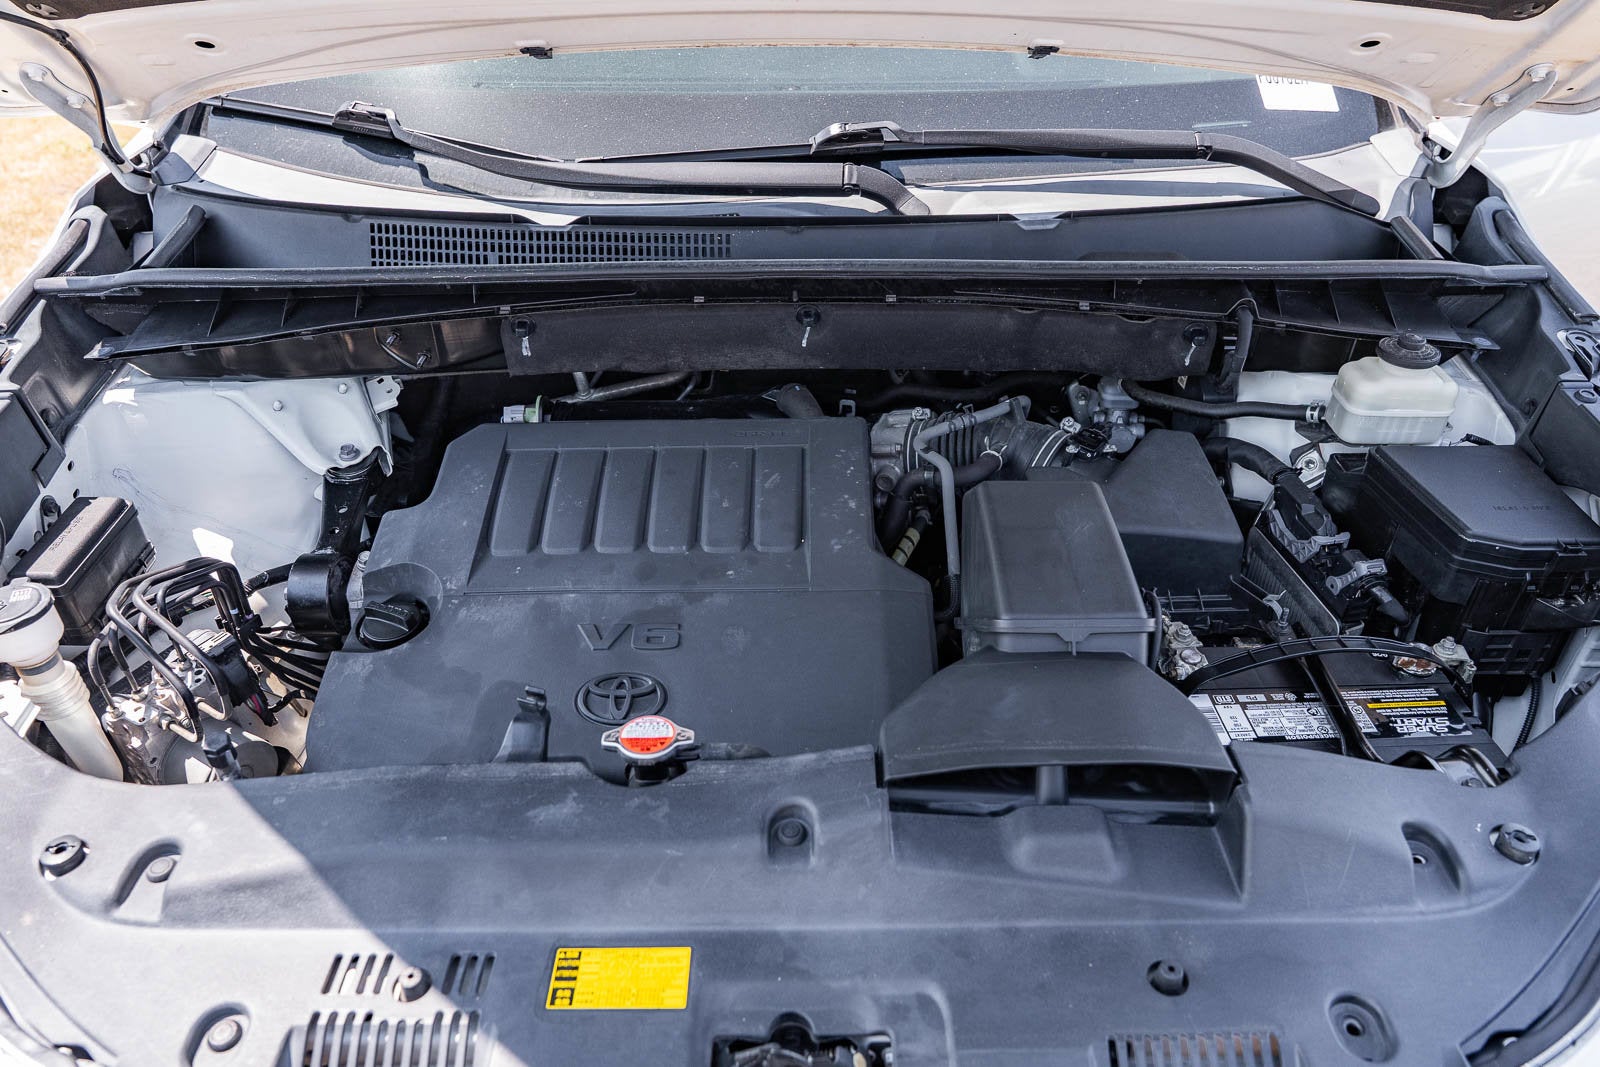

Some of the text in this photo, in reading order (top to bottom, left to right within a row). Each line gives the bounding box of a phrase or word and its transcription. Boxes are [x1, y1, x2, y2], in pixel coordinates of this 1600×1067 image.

[577, 623, 681, 651] V6
[1394, 717, 1449, 727] START
[1395, 725, 1449, 733] SUPER
